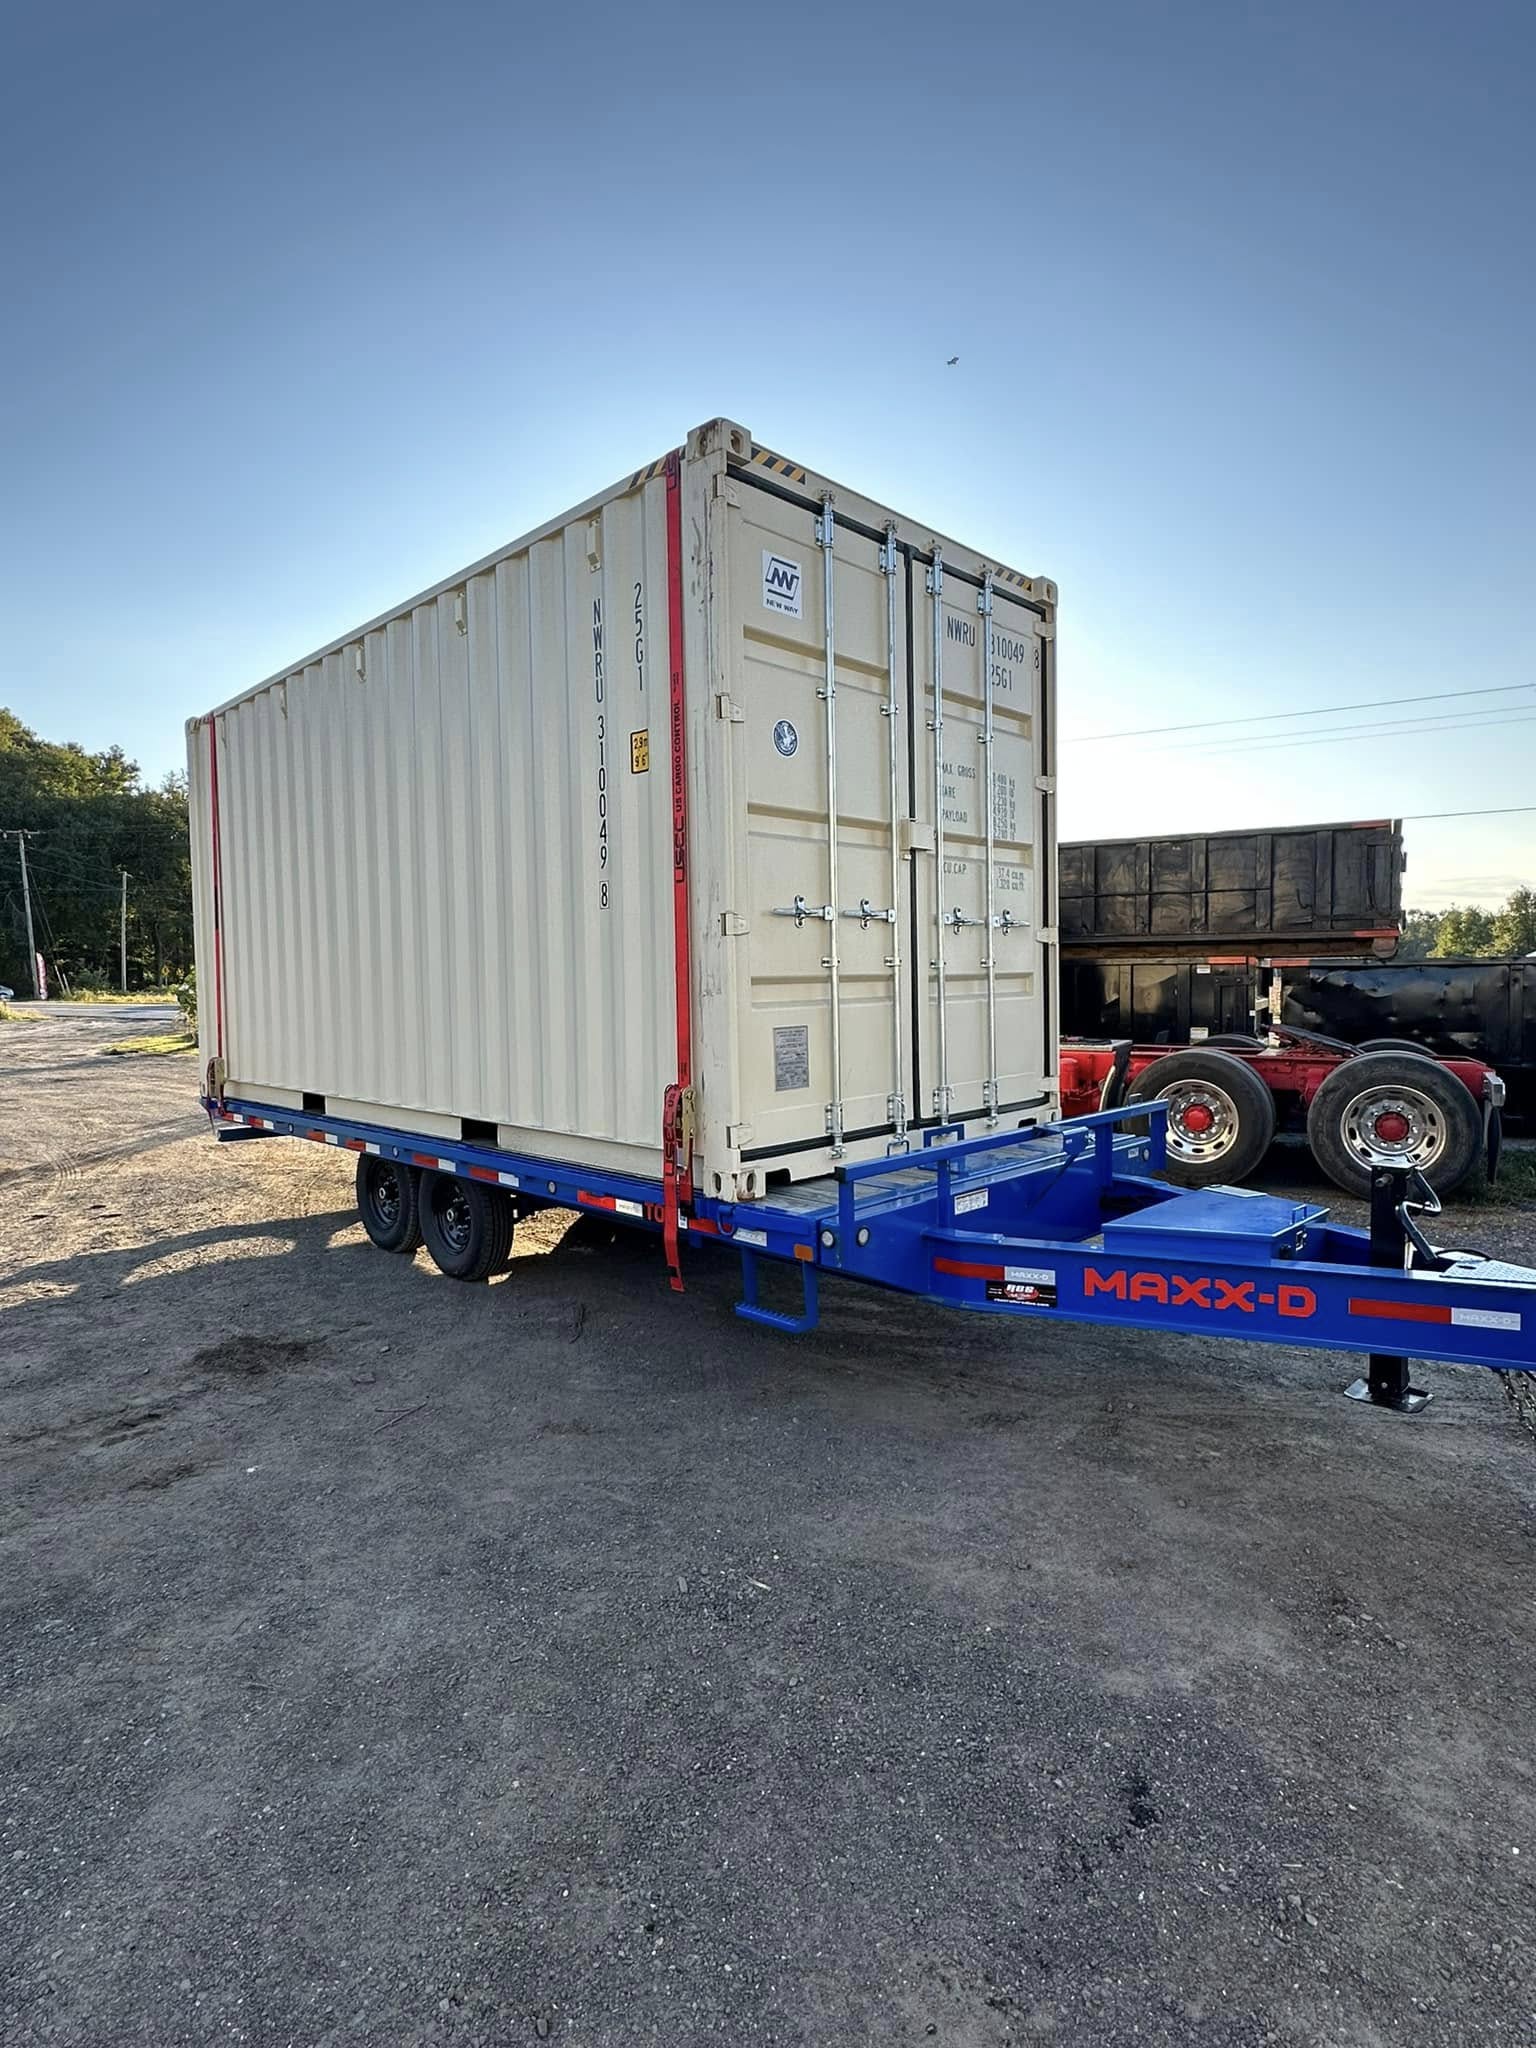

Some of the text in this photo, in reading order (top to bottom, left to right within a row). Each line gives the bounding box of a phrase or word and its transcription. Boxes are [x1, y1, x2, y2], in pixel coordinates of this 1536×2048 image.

[783, 605, 798, 614] WAY
[634, 582, 643, 691] 25G1
[947, 615, 975, 647] NWRU
[1033, 648, 1040, 670] 8
[673, 700, 681, 753] CONTROL
[593, 599, 608, 906] NWRU 310049 8
[674, 756, 682, 794] CARGO
[675, 797, 682, 812] US
[1084, 1268, 1317, 1317] MAXX-D
